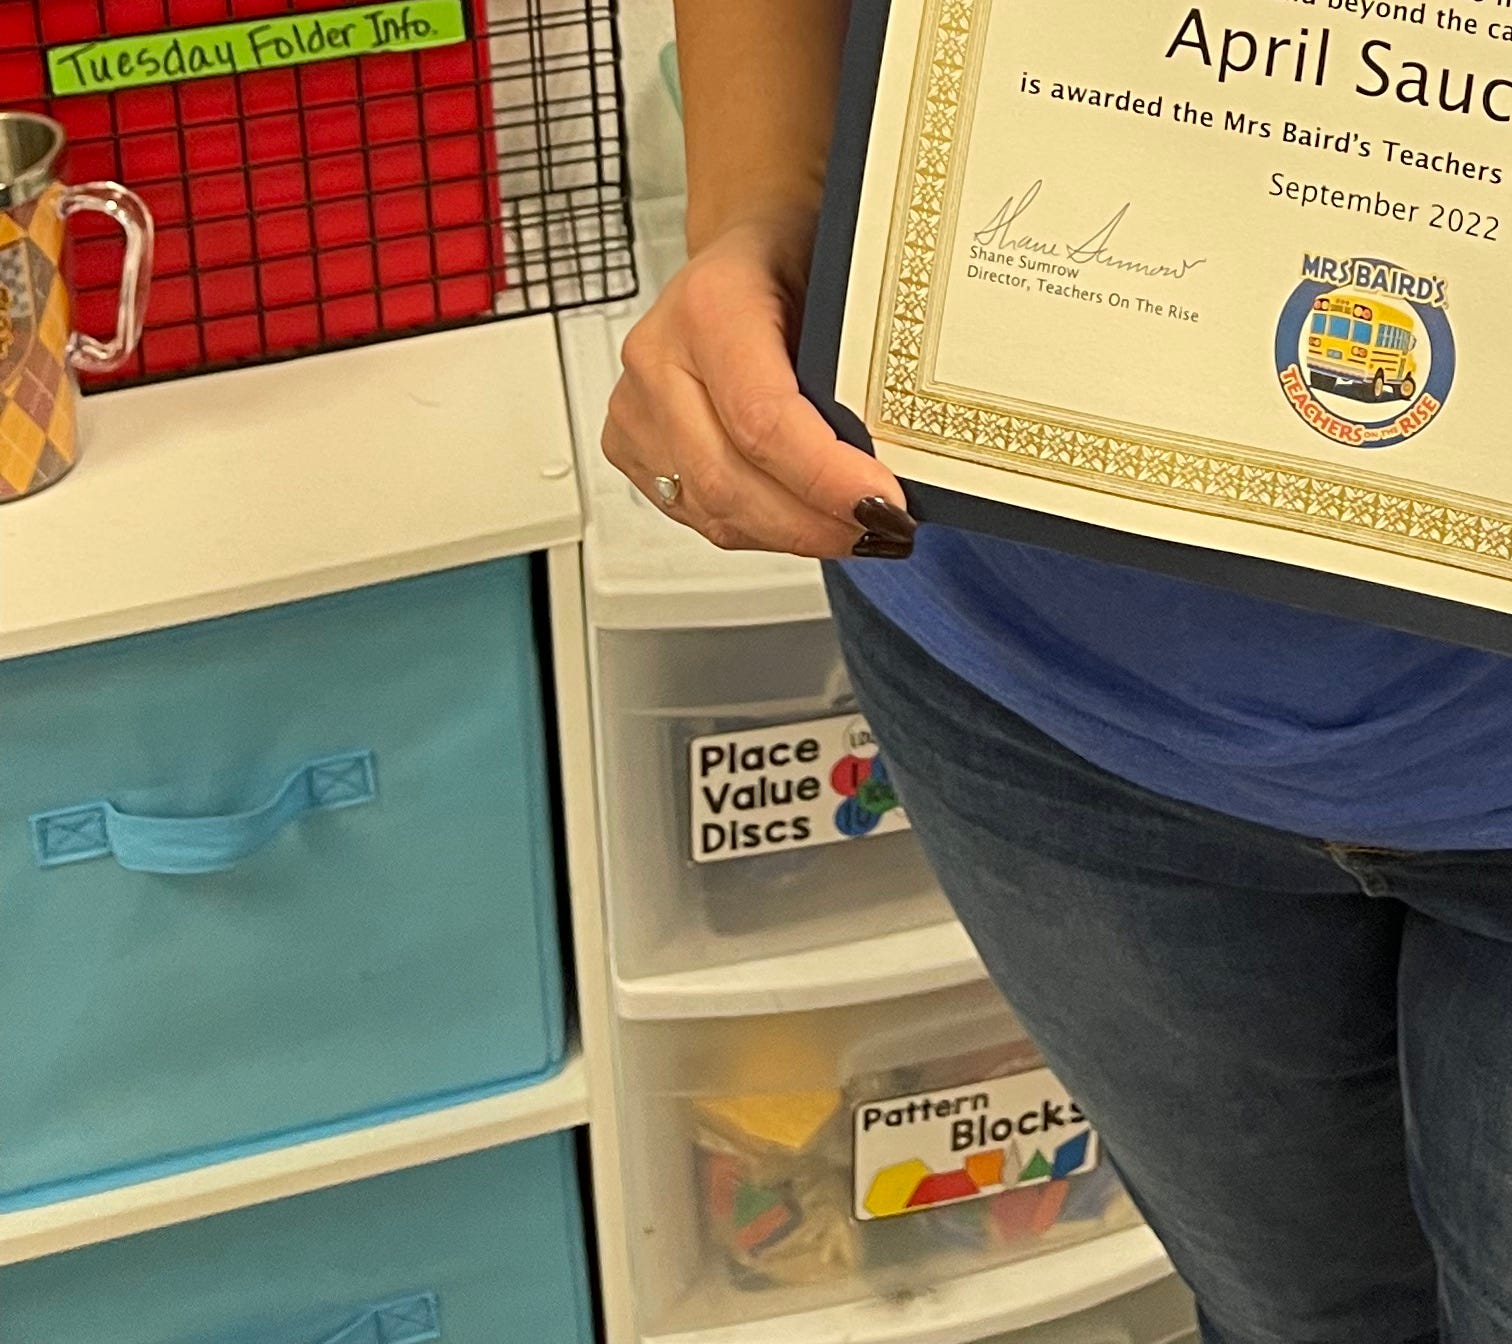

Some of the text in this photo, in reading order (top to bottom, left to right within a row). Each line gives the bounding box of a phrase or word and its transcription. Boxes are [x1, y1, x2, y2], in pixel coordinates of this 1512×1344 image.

[1164, 6, 1331, 88] April
[1436, 9, 1478, 36] the
[56, 40, 237, 89] Tuesday
[247, 22, 357, 67] Folder
[1019, 71, 1042, 96] is
[1050, 80, 1163, 119] awarded
[1172, 102, 1215, 129] the
[1223, 110, 1272, 139] Mrs
[1281, 121, 1372, 158] Baird's
[1382, 139, 1503, 184] Teachers
[1267, 172, 1500, 242] September 2022
[969, 245, 1080, 280] Shane Sumrow
[966, 263, 1200, 324] Director, Teachers On The Rise
[1282, 366, 1364, 444] TEACHERS
[1399, 395, 1438, 434] RISE
[699, 737, 820, 778] Place
[702, 775, 821, 815] Value
[701, 815, 812, 854] Discs
[863, 1092, 990, 1132] Pattern
[950, 1100, 1087, 1153] Blocks
